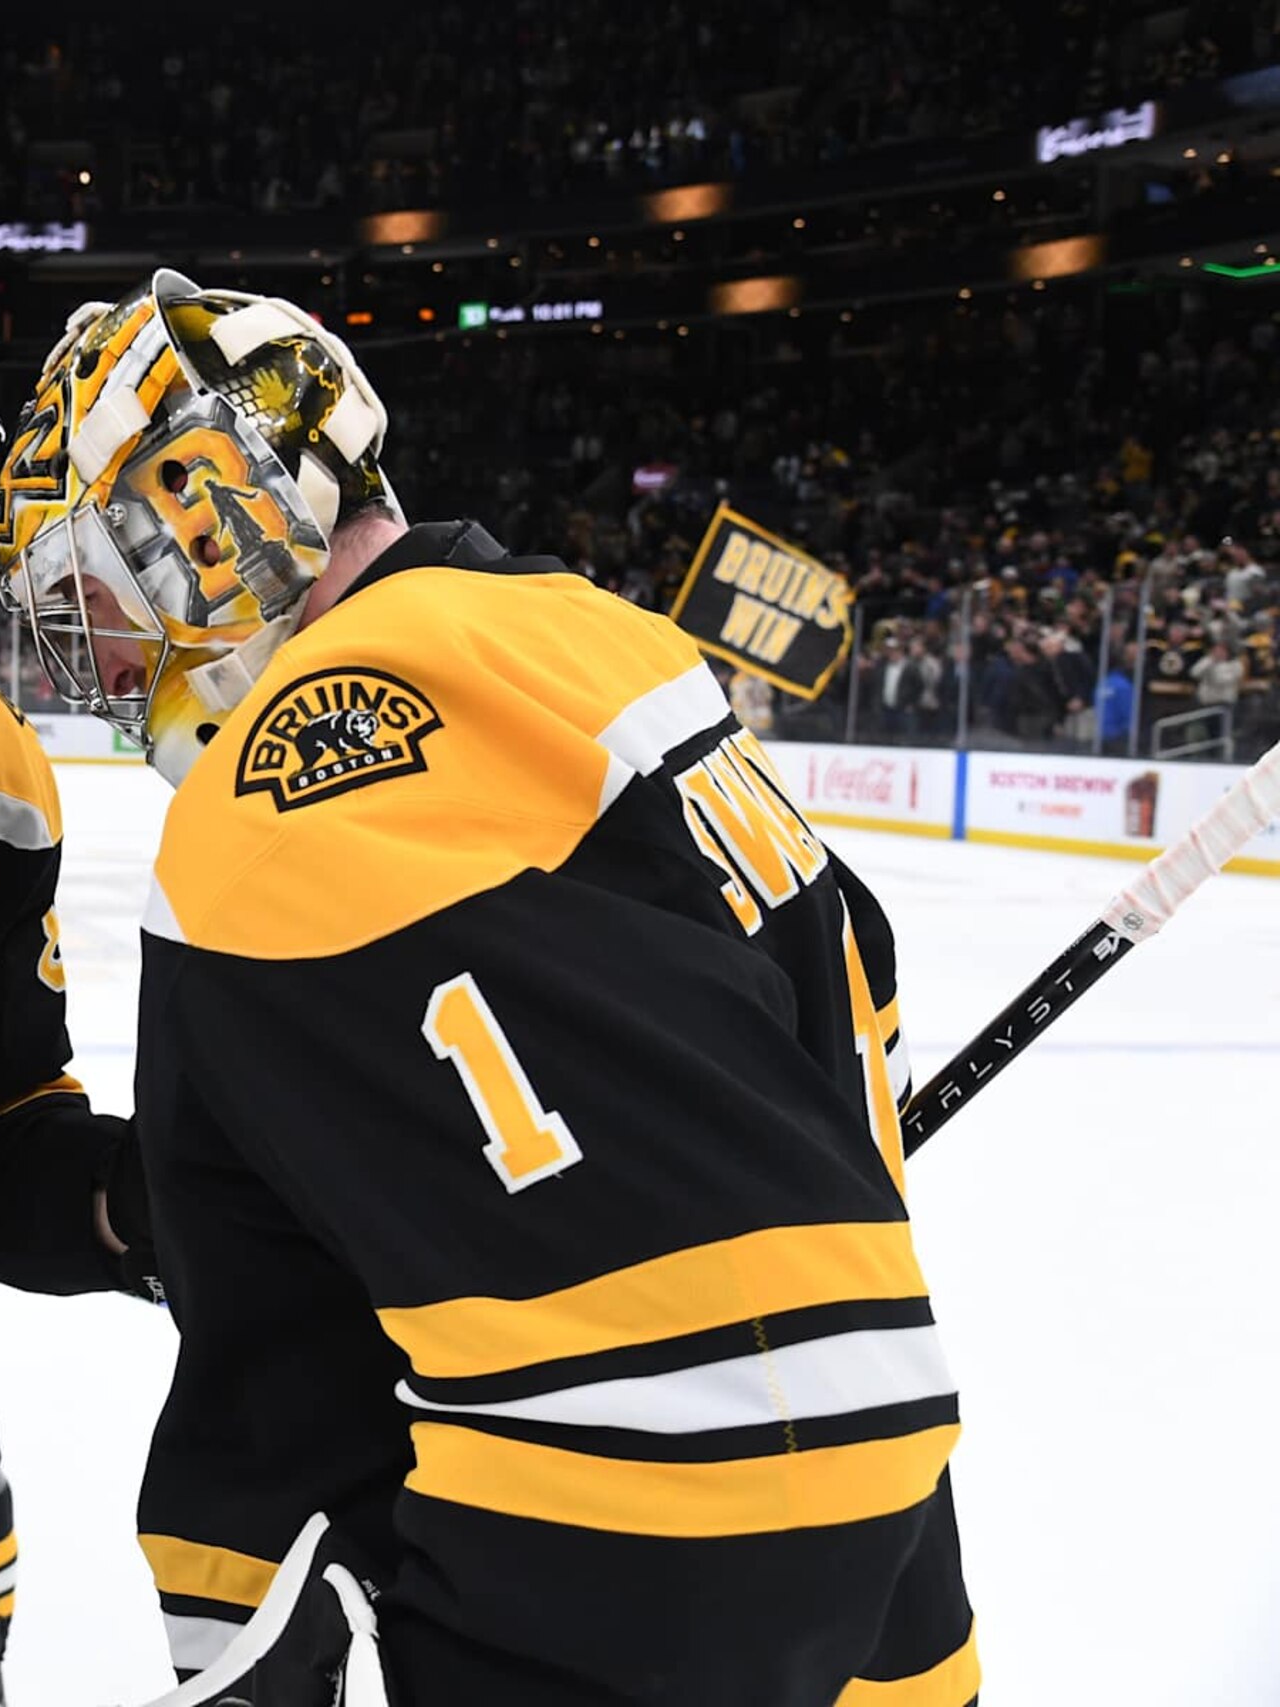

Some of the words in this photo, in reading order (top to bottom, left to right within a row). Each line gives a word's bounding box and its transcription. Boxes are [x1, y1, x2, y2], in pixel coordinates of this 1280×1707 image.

[713, 531, 847, 629] BRUINS
[720, 592, 804, 665] WIN
[251, 681, 421, 773] BRUINS
[298, 748, 394, 787] BOSTON
[421, 971, 584, 1194] 1
